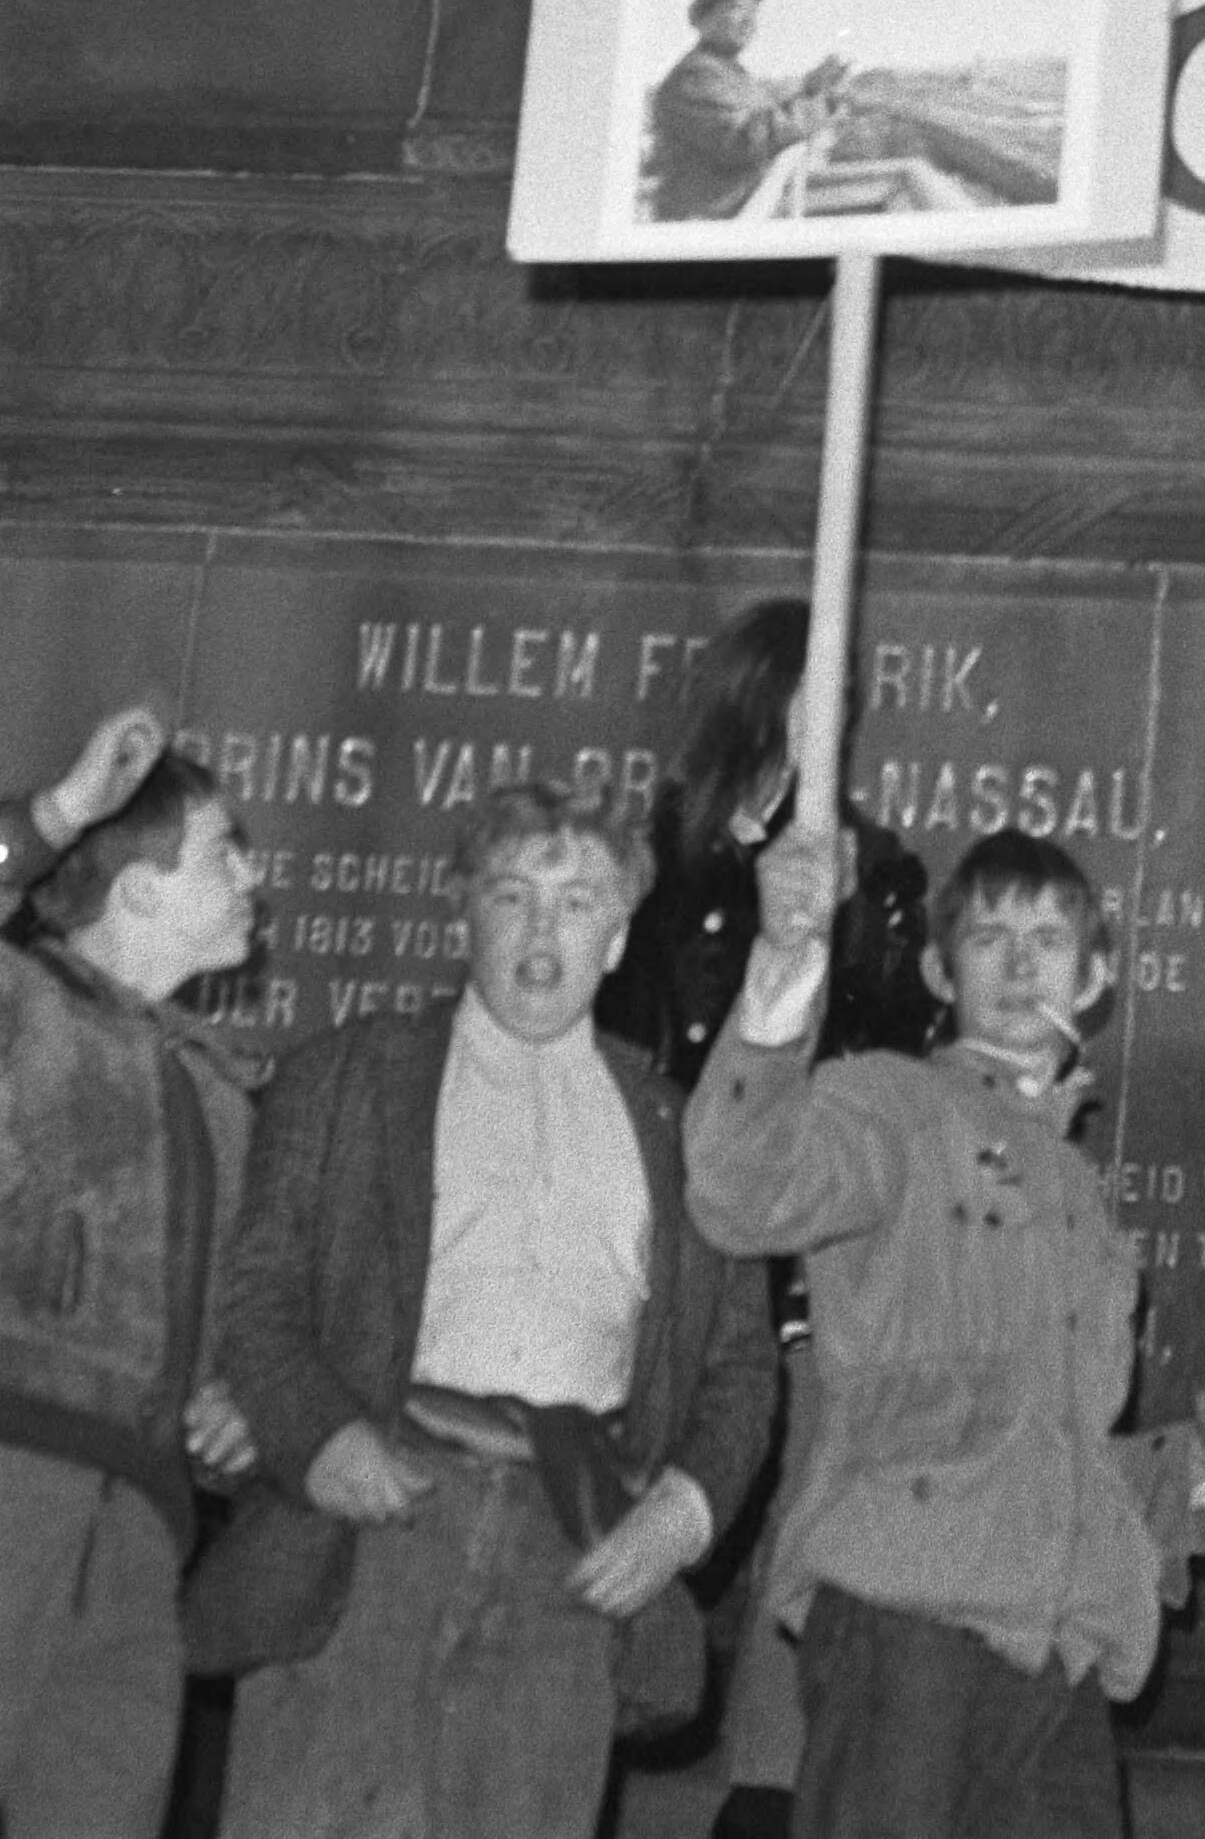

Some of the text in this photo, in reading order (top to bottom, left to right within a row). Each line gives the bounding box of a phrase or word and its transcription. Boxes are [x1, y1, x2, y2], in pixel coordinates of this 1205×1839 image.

[357, 622, 599, 699] WILLEM
[412, 736, 533, 811] VAN
[294, 914, 376, 957] 1813
[391, 918, 471, 960] VOO
